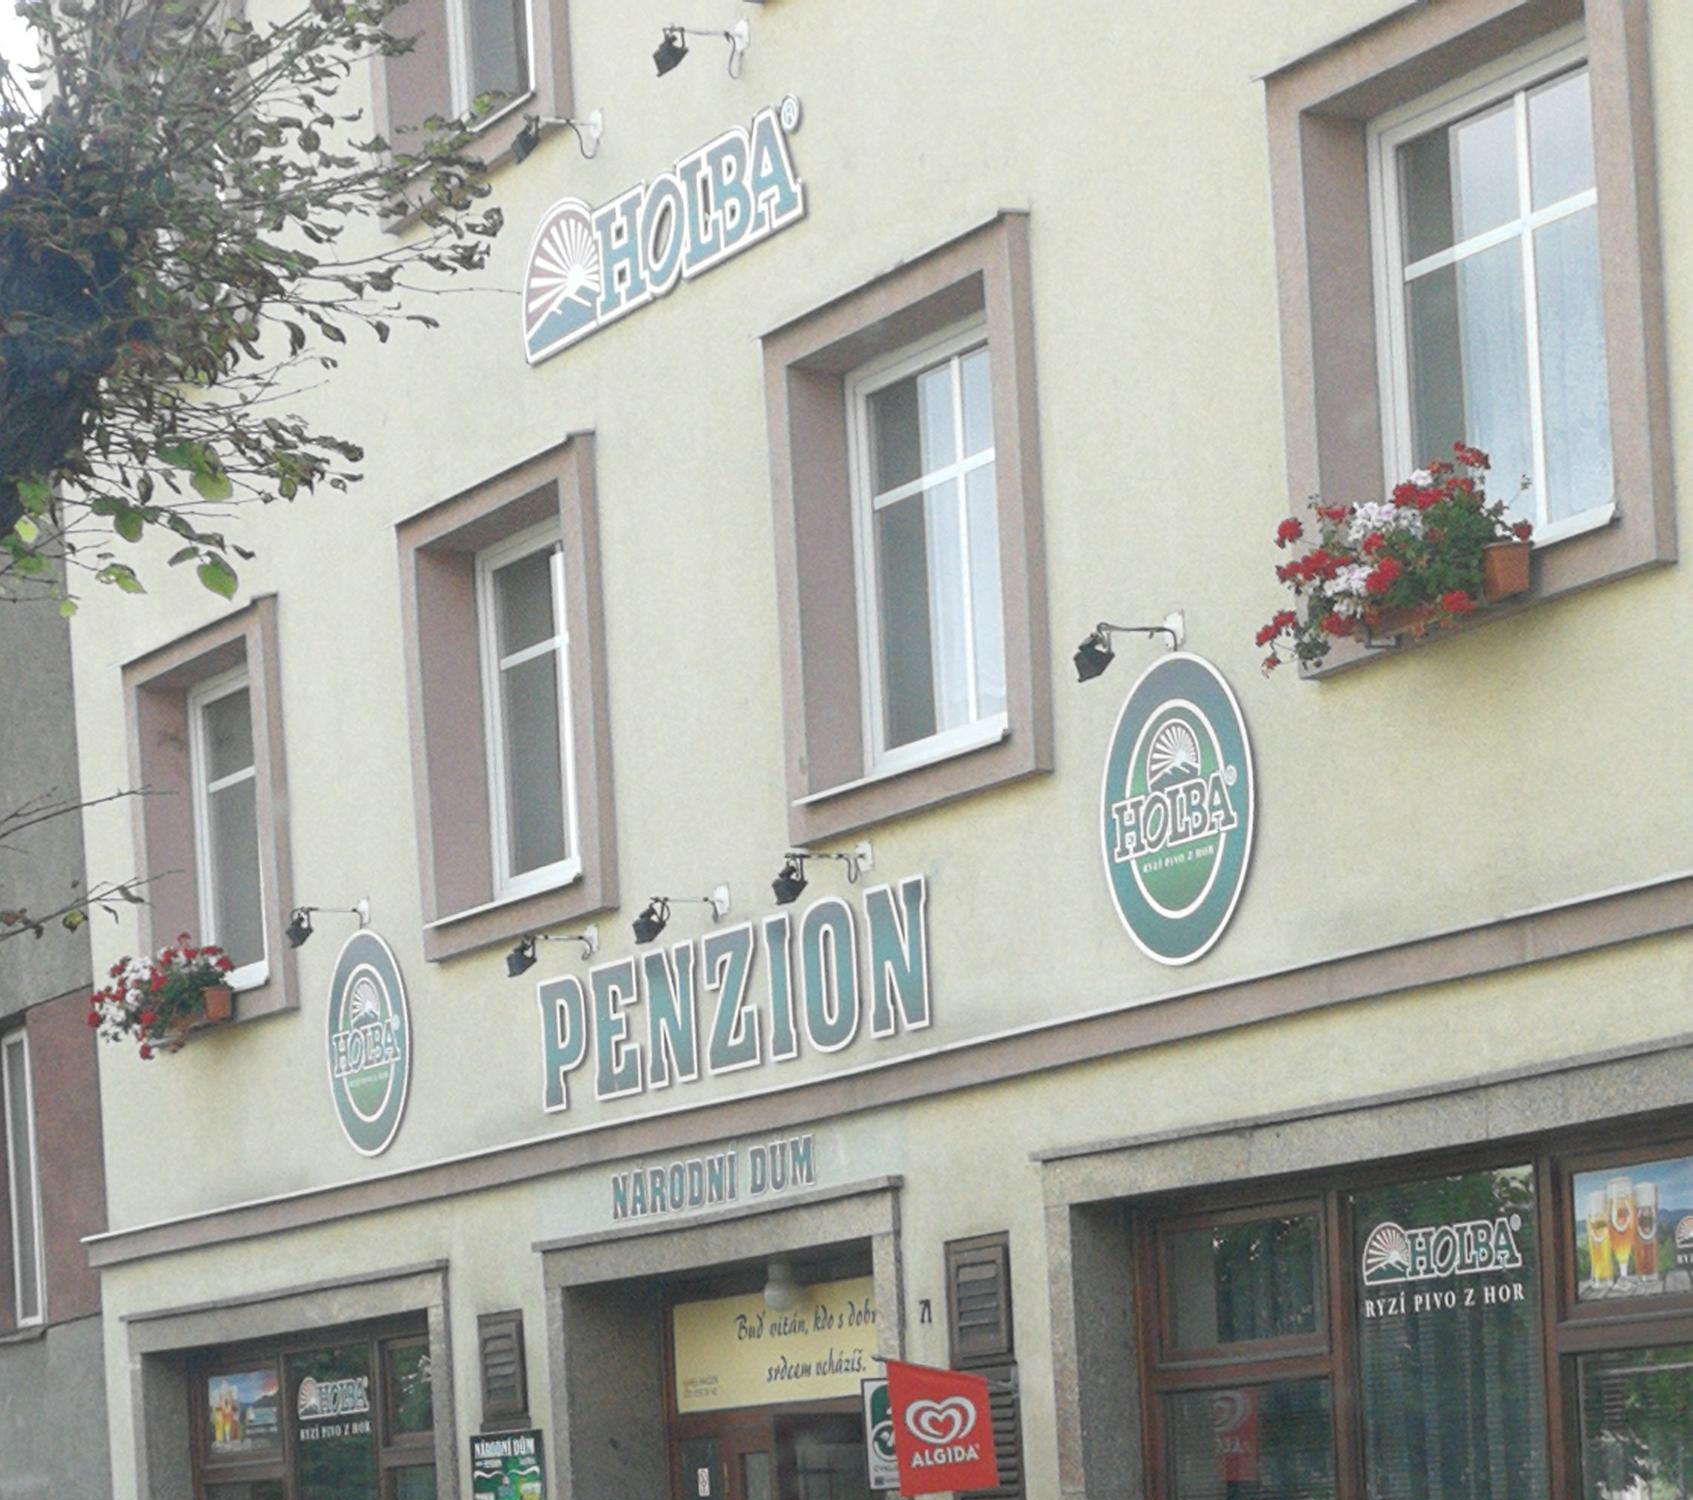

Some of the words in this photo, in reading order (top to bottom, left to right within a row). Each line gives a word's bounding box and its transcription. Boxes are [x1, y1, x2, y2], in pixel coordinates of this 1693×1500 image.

[592, 106, 803, 323] HOLBA
[1112, 772, 1238, 863] HOLBA
[537, 873, 931, 1113] PENZION
[332, 1018, 401, 1078] HOLBA
[1405, 1217, 1523, 1278] HOLBA
[1365, 1291, 1406, 1318] RYZÍ
[1414, 1290, 1456, 1313] PIVO
[1464, 1288, 1476, 1306] Z
[1484, 1283, 1525, 1304] HOR
[911, 1445, 980, 1468] ALGIDA
